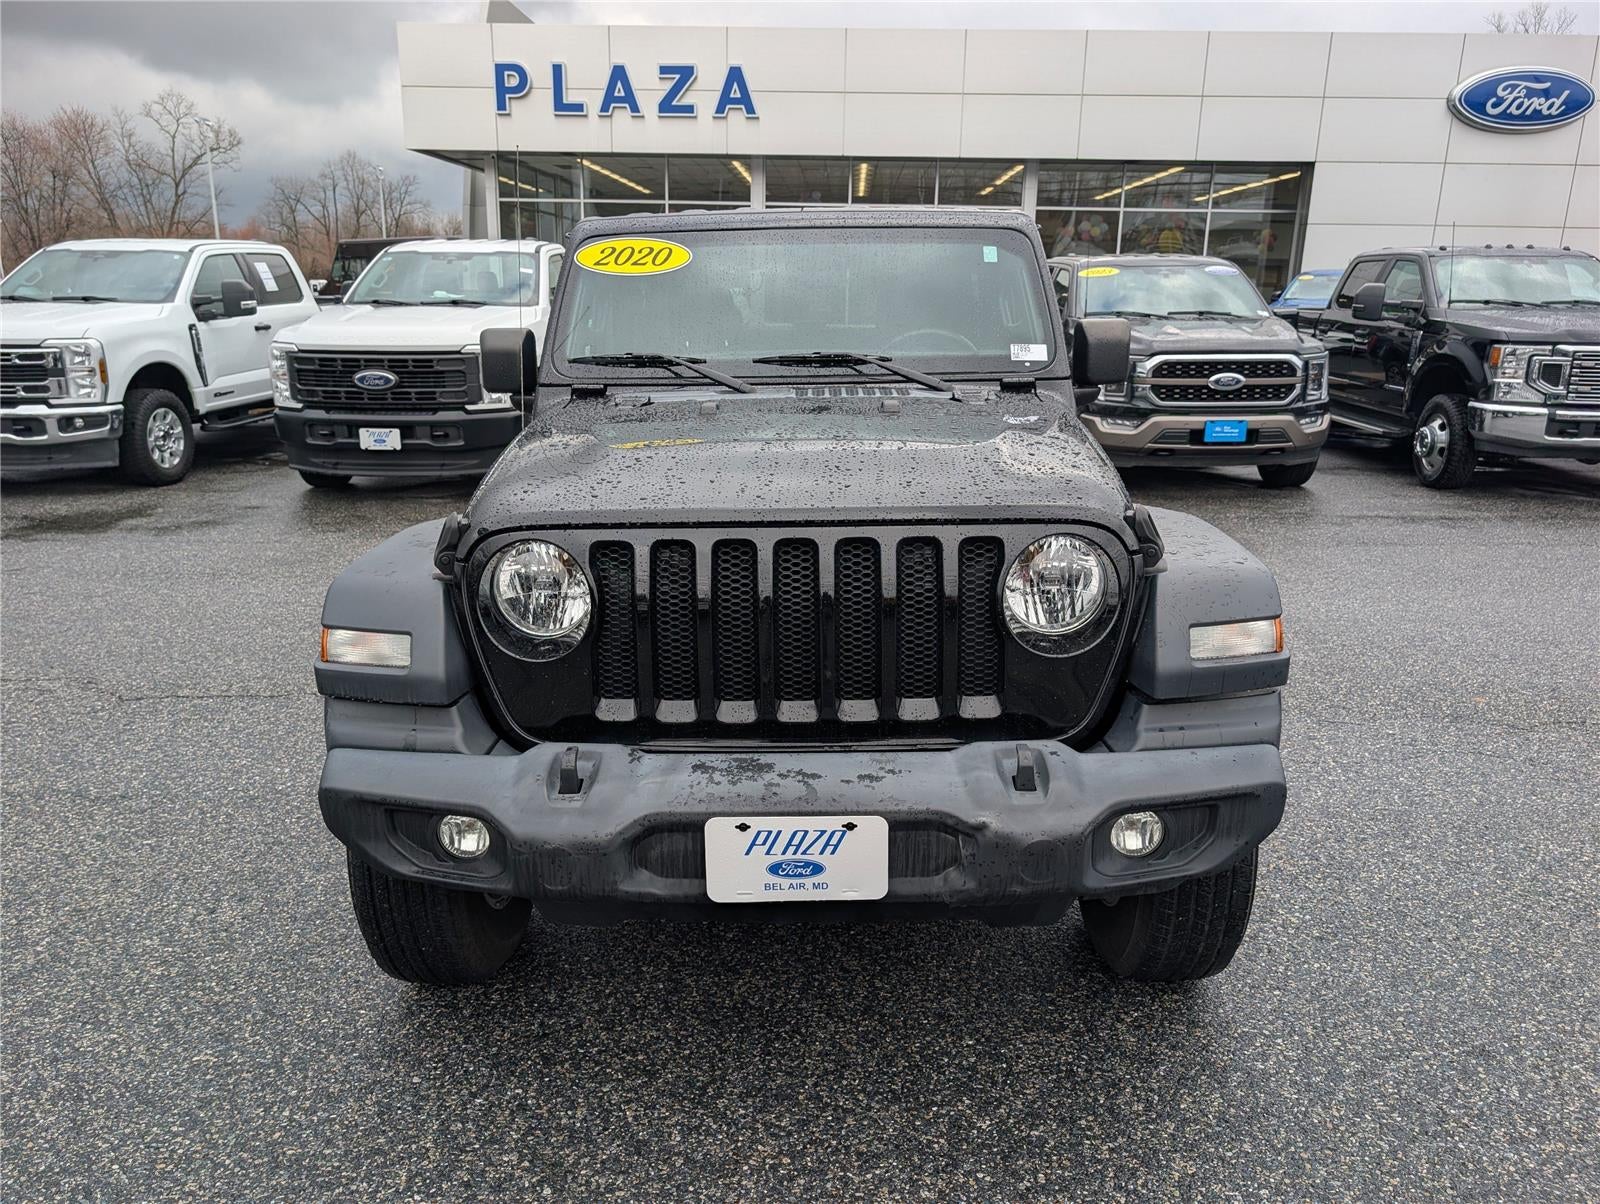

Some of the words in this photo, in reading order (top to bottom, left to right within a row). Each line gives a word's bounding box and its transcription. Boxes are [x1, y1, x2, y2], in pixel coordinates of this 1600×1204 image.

[493, 60, 760, 118] PLAZA
[1485, 80, 1571, 116] Ford
[593, 246, 673, 267] 2020
[363, 375, 386, 386] Ford
[744, 829, 848, 856] PLAZA
[778, 861, 813, 876] Ford
[764, 882, 786, 891] BEL
[788, 882, 810, 891] AIR,
[812, 881, 829, 891] MD
